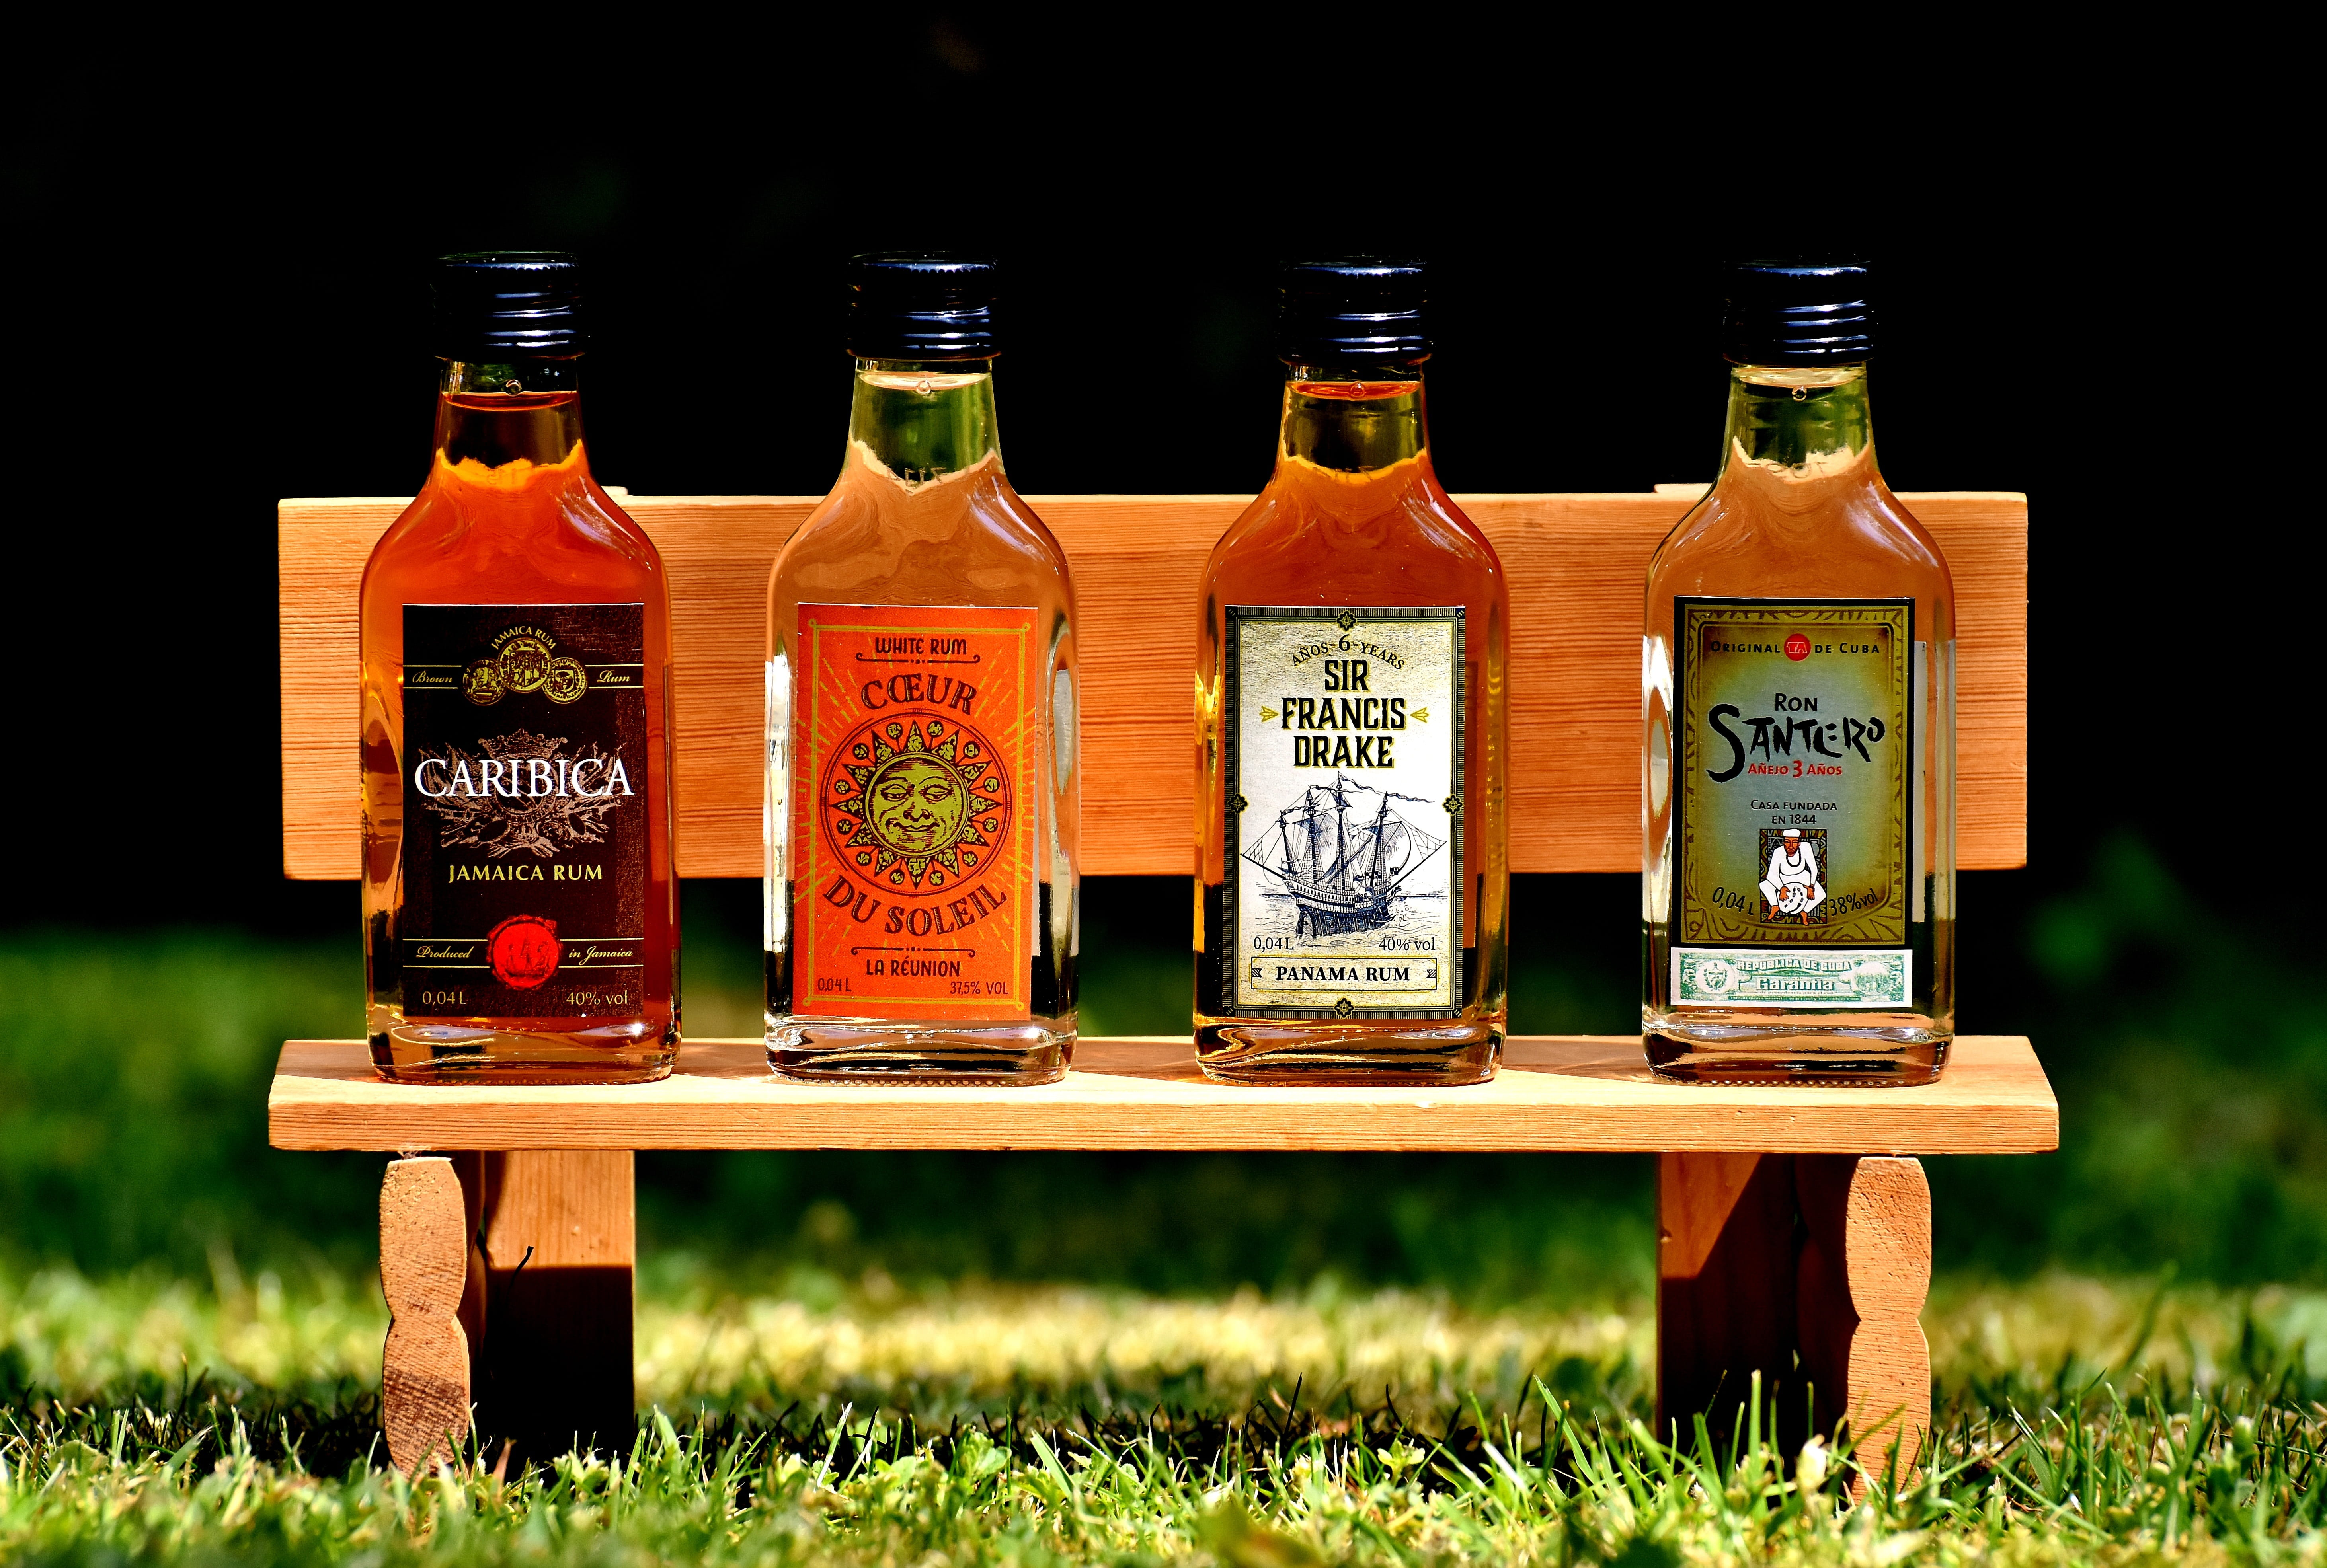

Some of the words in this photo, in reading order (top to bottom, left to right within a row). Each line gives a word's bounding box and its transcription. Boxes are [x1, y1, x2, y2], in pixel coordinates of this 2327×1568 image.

[491, 626, 532, 650] JAMAICA
[535, 629, 556, 649] RUM
[876, 637, 925, 655] WHITE
[930, 638, 967, 655] RUM
[1292, 642, 1329, 667] AÑOS
[1338, 634, 1351, 651] 6
[1360, 641, 1405, 670] YEARS
[1711, 641, 1780, 654] ORIGINAL
[1815, 644, 1832, 654] DE
[1839, 642, 1880, 654] CUBA
[412, 670, 453, 683] Brown
[597, 670, 632, 683] Rum
[1324, 659, 1369, 691] SIR
[860, 673, 977, 716] CŒUR
[1774, 693, 1818, 712] RON
[1281, 697, 1406, 729] FRANCIS
[1293, 735, 1394, 768] DRAKE
[1706, 703, 1886, 783] SANTERO
[414, 758, 635, 797] CARIBICA
[1748, 762, 1789, 776] AÑEJO
[1792, 760, 1803, 778] 3
[1806, 763, 1843, 776] AÑOS
[1750, 799, 1780, 810] CASA
[1783, 800, 1837, 811] FUNDADA
[1771, 816, 1786, 825] EN
[1789, 814, 1817, 825] 1844
[449, 865, 544, 883] JAMAICA
[554, 865, 602, 880] RUM
[823, 875, 881, 923] DU
[884, 884, 1007, 937] SOLEIL
[1712, 886, 1746, 913] 0,04
[1378, 938, 1410, 951] 40%
[1414, 937, 1436, 951] vol
[415, 946, 475, 959] Produced
[568, 949, 581, 958] in
[578, 946, 633, 966] Jamaica
[1737, 958, 1802, 972] REPUBLICA
[1802, 960, 1820, 972] DE
[1820, 960, 1853, 972] CUBA
[866, 958, 884, 976] LA
[891, 955, 960, 977] RÉUNION
[1276, 966, 1359, 981] PANAMA
[1365, 967, 1410, 982] RUM
[817, 978, 842, 993] 0,04
[950, 981, 981, 995] 37,5%
[985, 982, 1009, 995] VOL
[422, 991, 455, 1007] 0,04
[566, 992, 600, 1005] 40%
[606, 990, 628, 1005] vol
